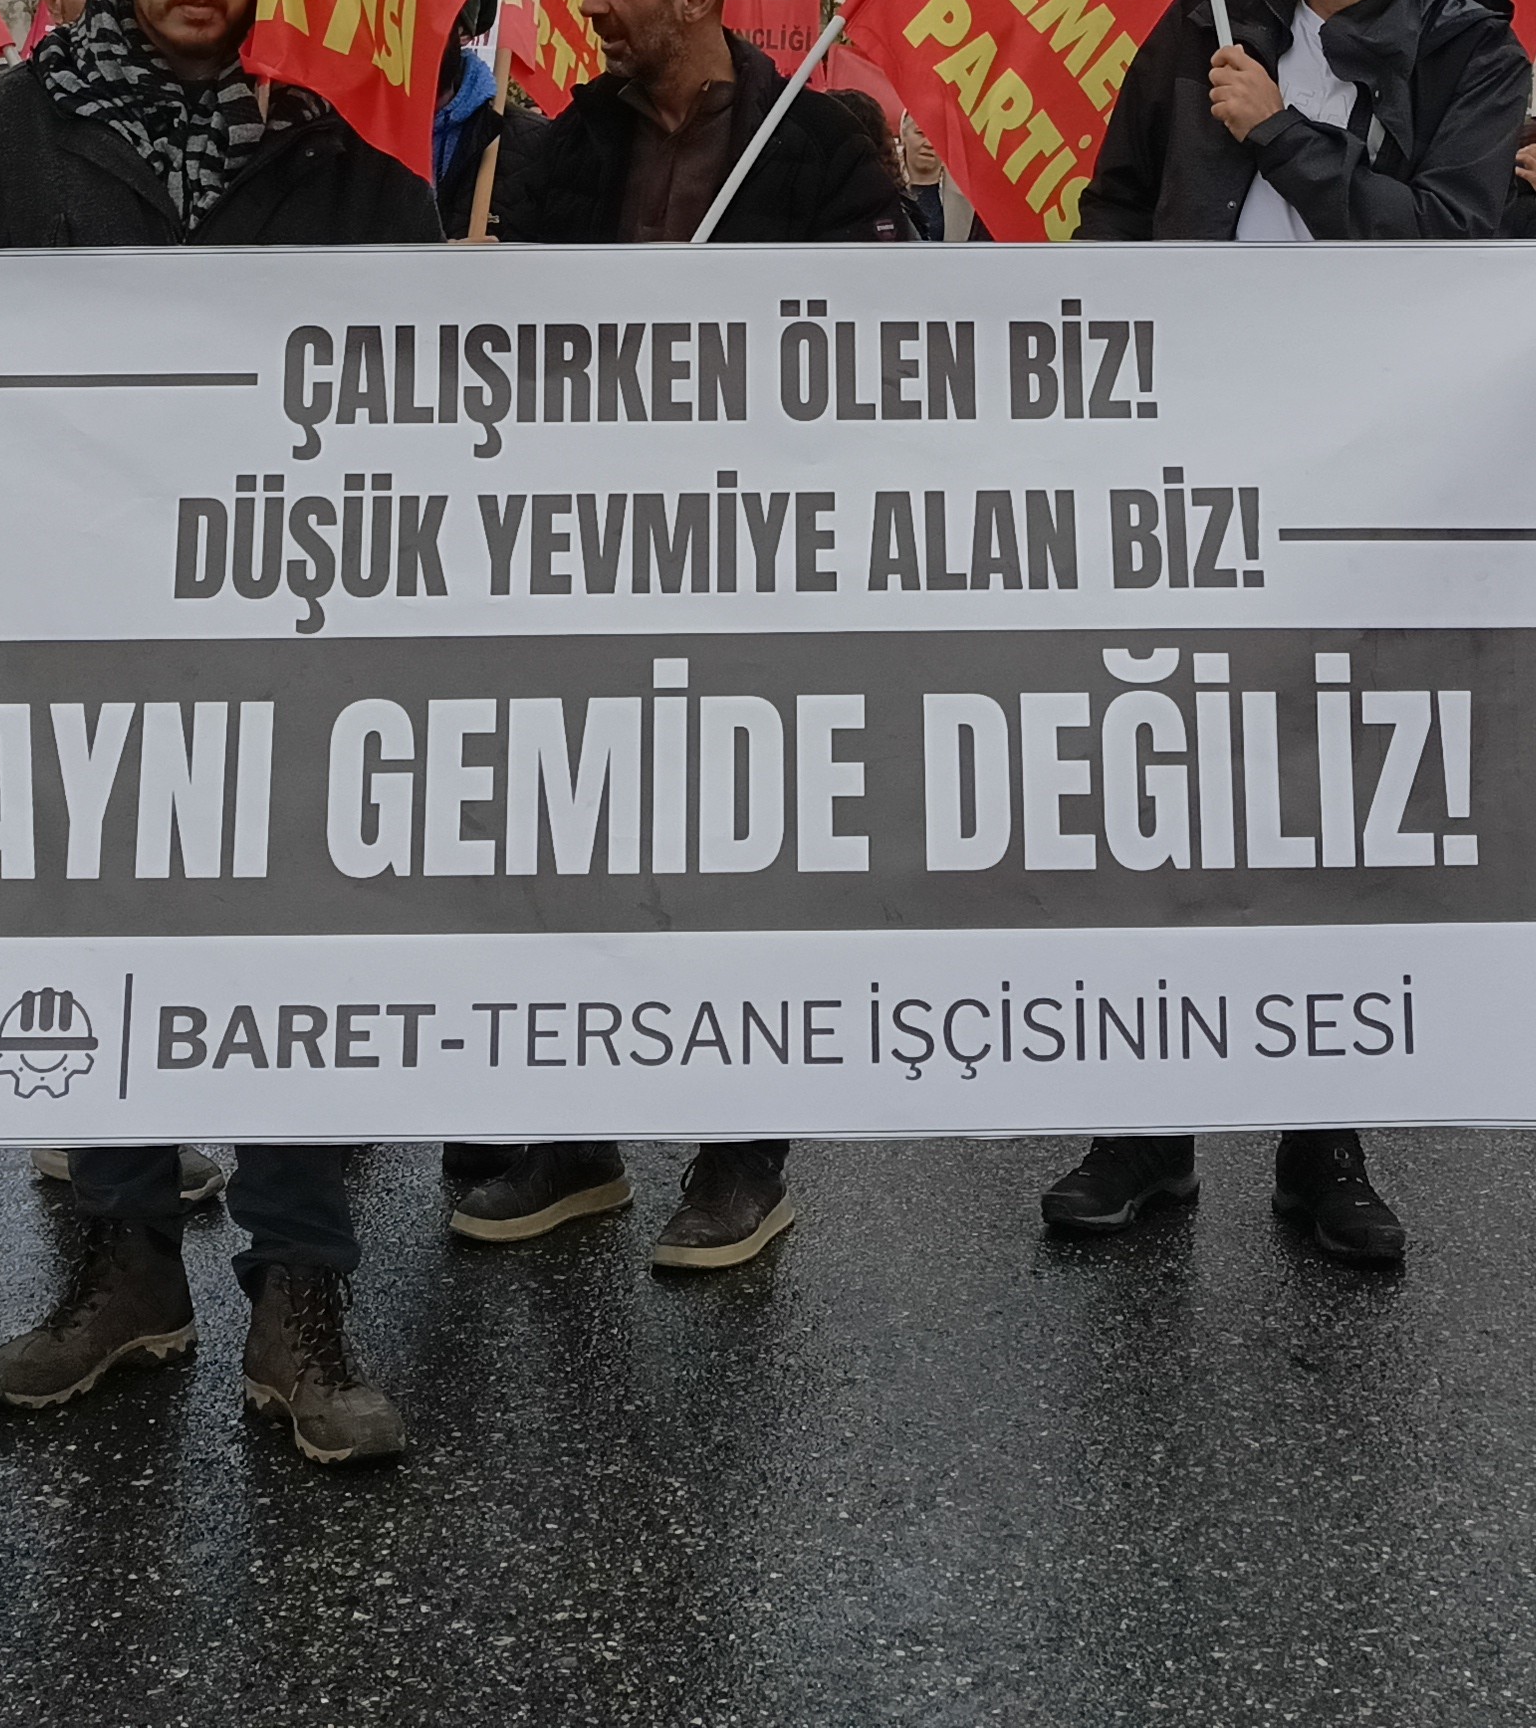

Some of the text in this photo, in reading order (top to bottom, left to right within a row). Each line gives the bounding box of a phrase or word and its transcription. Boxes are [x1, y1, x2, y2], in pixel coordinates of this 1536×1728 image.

[284, 299, 1155, 460] ÇALIŞIRKEN ÖLEN BİZ!
[174, 467, 1265, 634] DÜŞÜK YEVMİYE ALAN BİZ!
[327, 658, 869, 878] GEMİDE
[923, 648, 1479, 871] DEĞİLİZ!
[157, 974, 1415, 1080] BARET-TERSANE İŞÇİSİNİN SESİ
